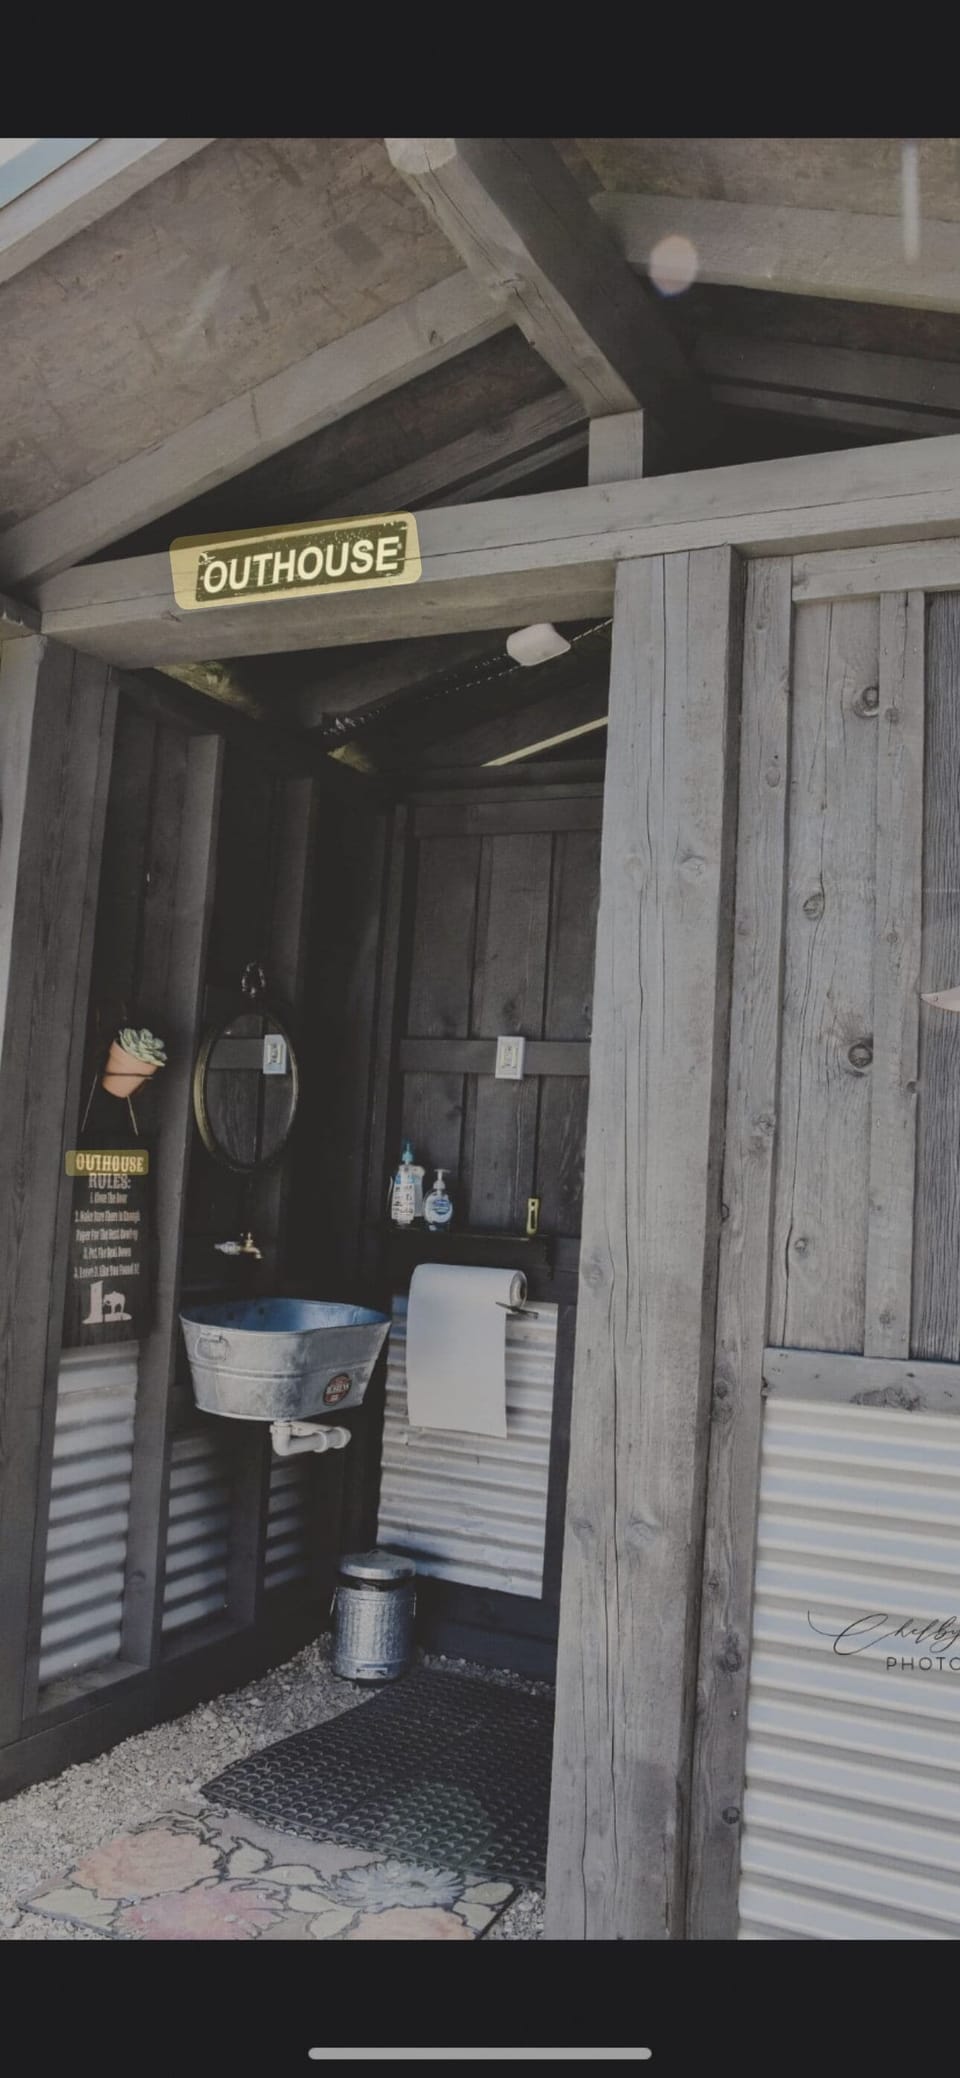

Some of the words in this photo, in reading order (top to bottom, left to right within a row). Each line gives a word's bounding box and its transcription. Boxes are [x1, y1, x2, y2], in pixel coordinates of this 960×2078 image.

[202, 536, 400, 594] OUTHOUSE
[75, 1153, 144, 1172] OUTHOUSE
[88, 1173, 132, 1190] RULES:
